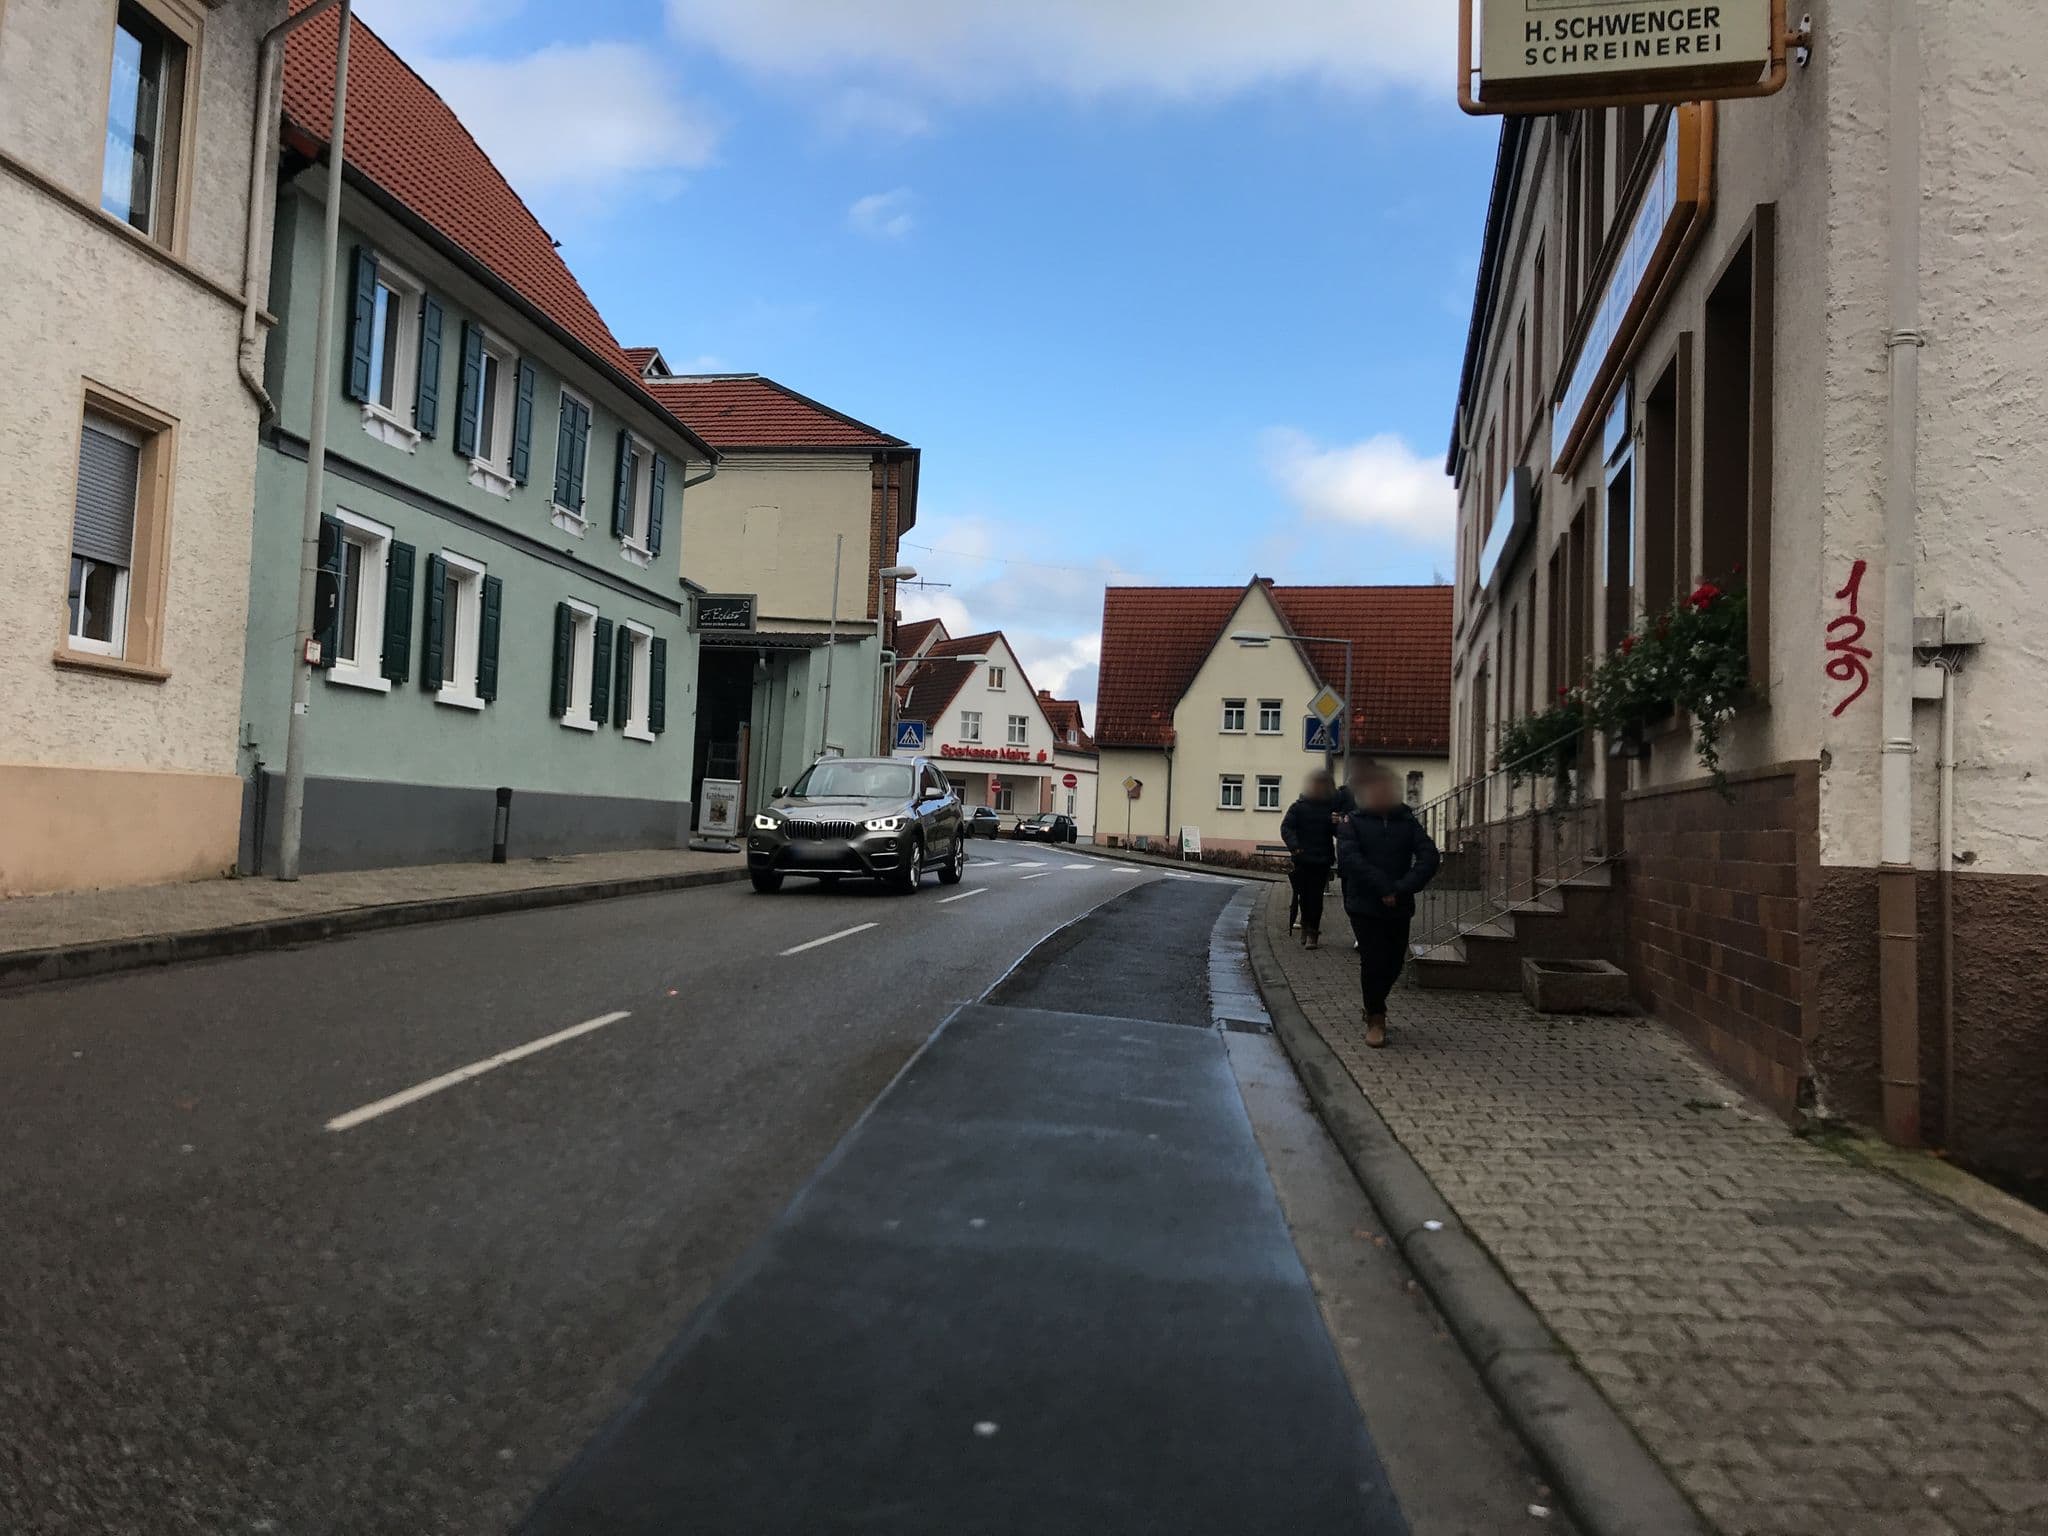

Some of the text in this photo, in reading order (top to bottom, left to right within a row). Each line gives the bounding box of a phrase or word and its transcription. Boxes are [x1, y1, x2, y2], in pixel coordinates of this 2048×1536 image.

[1524, 33, 1722, 66] SCHREINEREI
[941, 744, 1030, 761] Sparkasse Mainz
